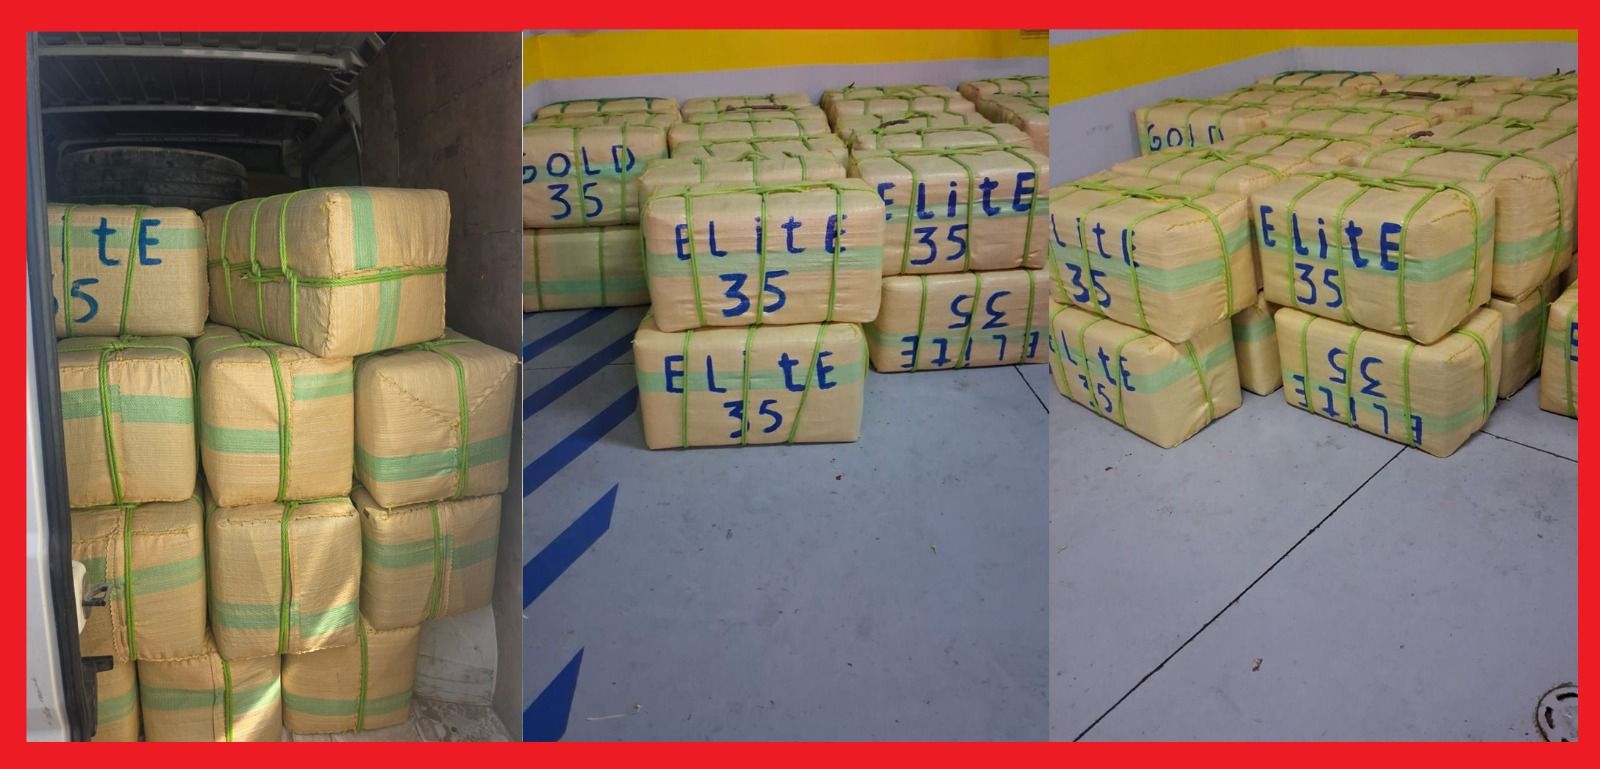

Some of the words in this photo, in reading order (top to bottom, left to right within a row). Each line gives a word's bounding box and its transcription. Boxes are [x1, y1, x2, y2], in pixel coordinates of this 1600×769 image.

[548, 182, 603, 220] 35
[910, 223, 969, 265] 35
[52, 273, 99, 323] 5
[719, 269, 789, 317] 35
[1065, 262, 1112, 308] 35
[1295, 262, 1343, 308] 35
[947, 290, 1012, 330] 35
[664, 350, 838, 394] ELtE
[1328, 347, 1387, 399] 35
[723, 398, 783, 438] 35
